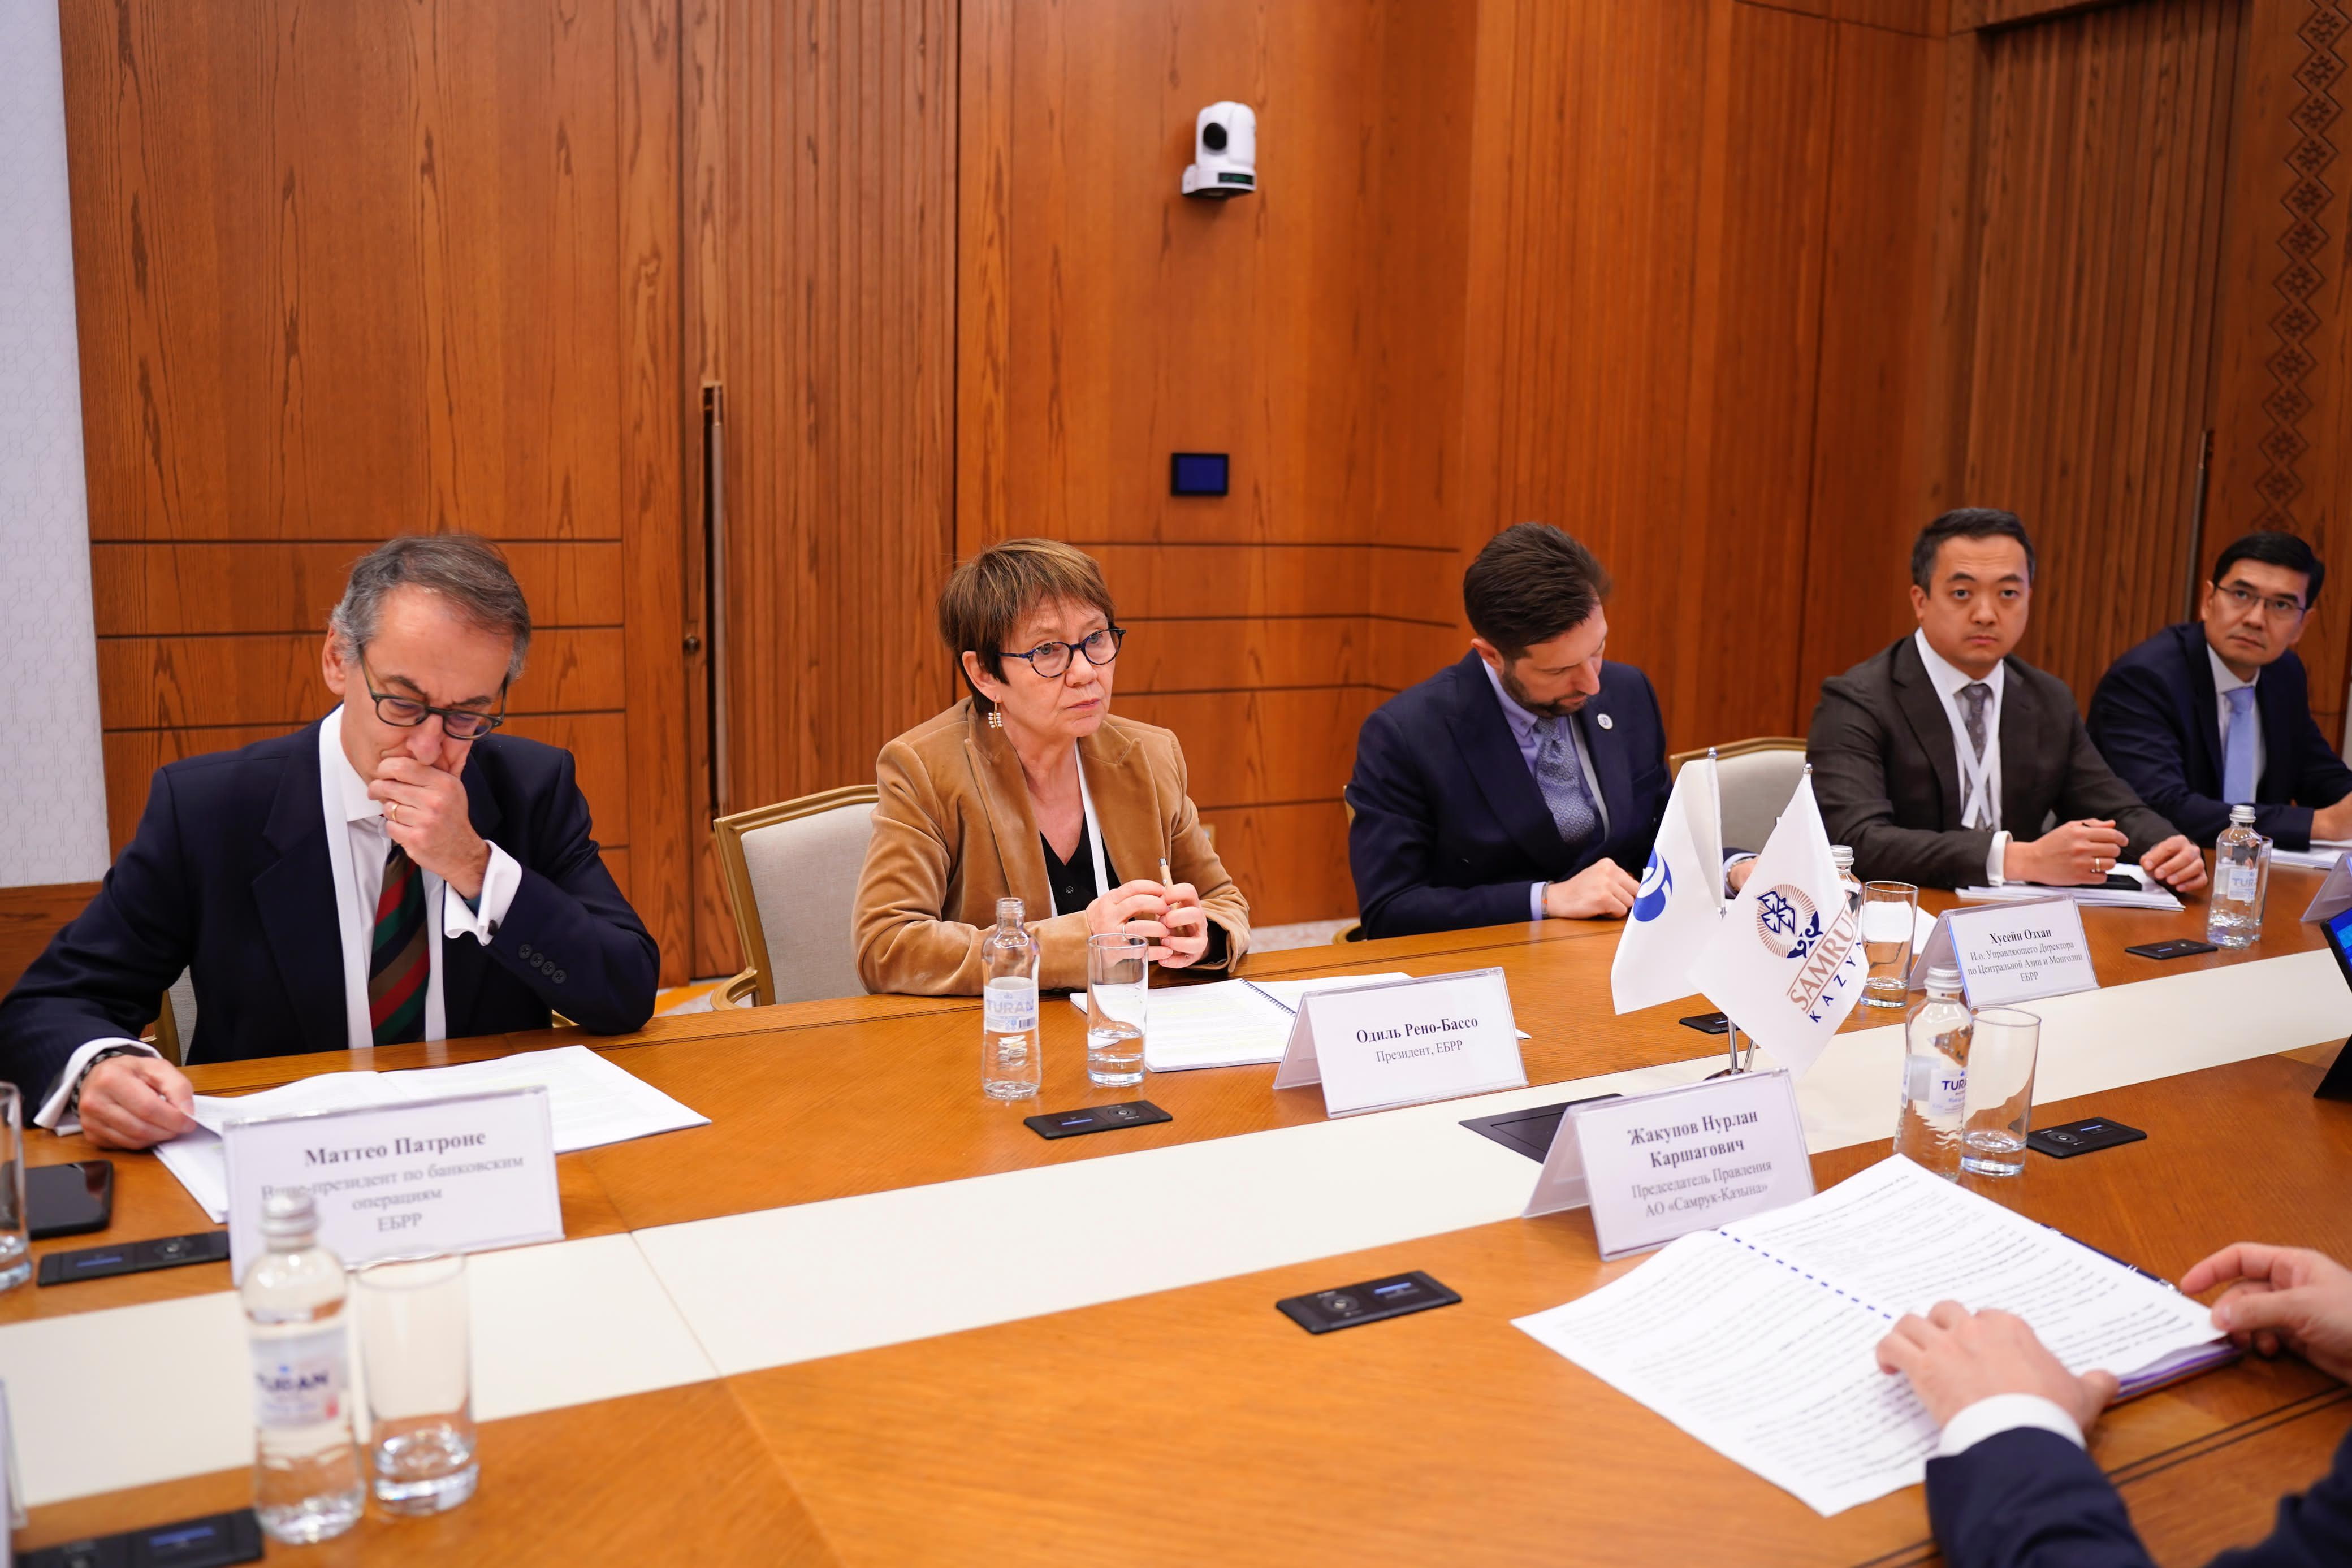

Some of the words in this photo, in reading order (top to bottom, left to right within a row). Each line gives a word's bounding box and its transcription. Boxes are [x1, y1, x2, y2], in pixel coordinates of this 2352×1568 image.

[1990, 931, 2022, 946] Хусейн
[2024, 929, 2052, 941] Озхан
[1970, 952, 1984, 961] И.о.
[1986, 946, 2038, 960] Управляющего
[2040, 941, 2074, 954] Директора
[1978, 960, 2023, 974] Центральной
[2025, 959, 2042, 968] Азии
[2049, 954, 2083, 965] Монголии
[2020, 971, 2039, 982] ЕБРР
[1356, 1029, 1402, 1043] Одиль
[1404, 1017, 1478, 1037] Рено-Бассо
[1376, 1046, 1434, 1064] Президент,
[1436, 1039, 1463, 1054] ЕБРР
[1627, 1123, 1699, 1146] Жакупов
[1702, 1110, 1758, 1134] Нурлан
[304, 1145, 388, 1167] Маттео
[395, 1132, 486, 1158] Патроне
[1650, 1138, 1745, 1168] Каршагович
[403, 1169, 424, 1183] по
[427, 1155, 524, 1180] банковским
[1631, 1173, 1710, 1201] Председатель
[1712, 1161, 1772, 1184] Правления
[352, 1188, 442, 1211] операциям
[1646, 1201, 1665, 1217] АО
[1667, 1183, 1769, 1210] «Самрук-Казына»
[377, 1212, 423, 1233] ЕБРР
